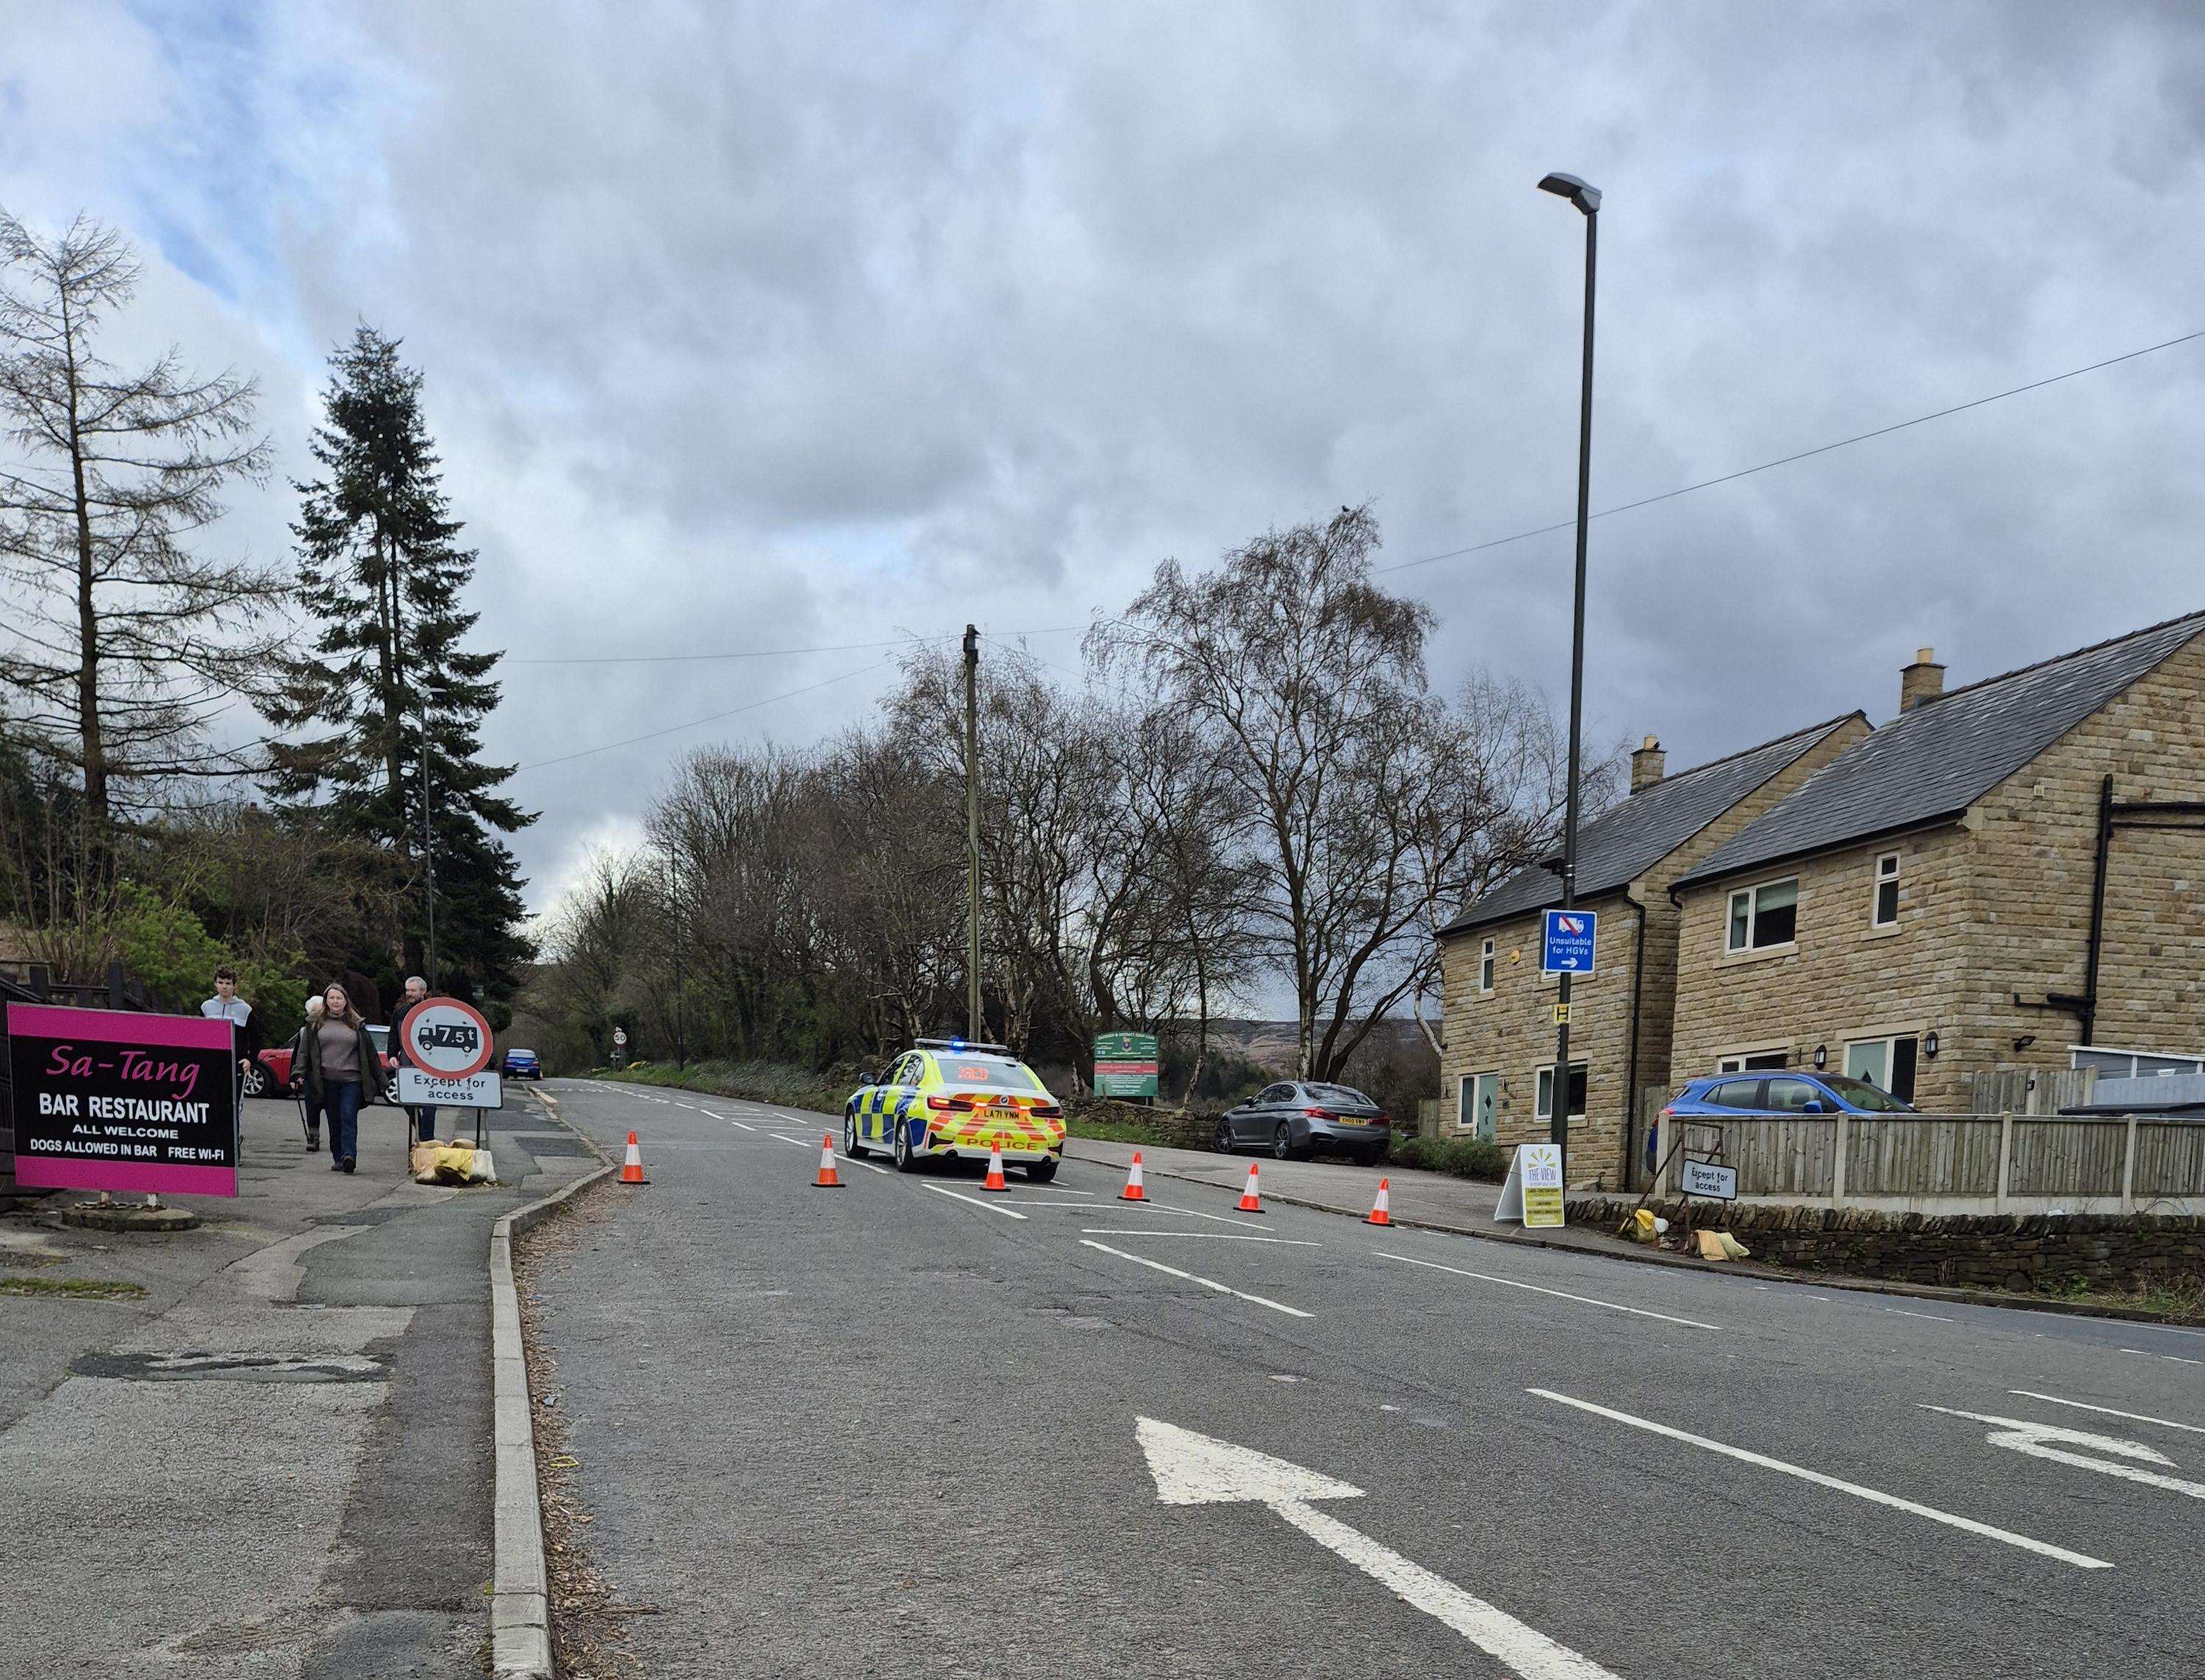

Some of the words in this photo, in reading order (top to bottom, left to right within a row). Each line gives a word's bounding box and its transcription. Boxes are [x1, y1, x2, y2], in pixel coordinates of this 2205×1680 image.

[1549, 936, 1592, 946] Unsuitable
[1552, 946, 1563, 954] for
[1566, 946, 1588, 955] HGVs
[1557, 1006, 1569, 1021] H
[46, 1045, 200, 1100] Sa-Tang
[414, 1074, 462, 1088] Except
[466, 1077, 486, 1088] for
[428, 1091, 474, 1100] access
[39, 1093, 79, 1116] BAR
[88, 1096, 209, 1124] RESTAURANT
[73, 1124, 101, 1135] ALL
[104, 1126, 179, 1139] WELCOME
[30, 1138, 62, 1152] DOGS
[64, 1141, 118, 1155] ALLOWED
[121, 1144, 132, 1155] IN
[134, 1144, 157, 1157] BAR
[168, 1146, 196, 1159] FREE
[198, 1148, 224, 1160] WI-FI
[1529, 1168, 1539, 1181] THE
[1541, 1167, 1557, 1180] VIEW
[1691, 1167, 1715, 1180] Except
[1716, 1172, 1729, 1182] for
[1695, 1182, 1721, 1192] access
